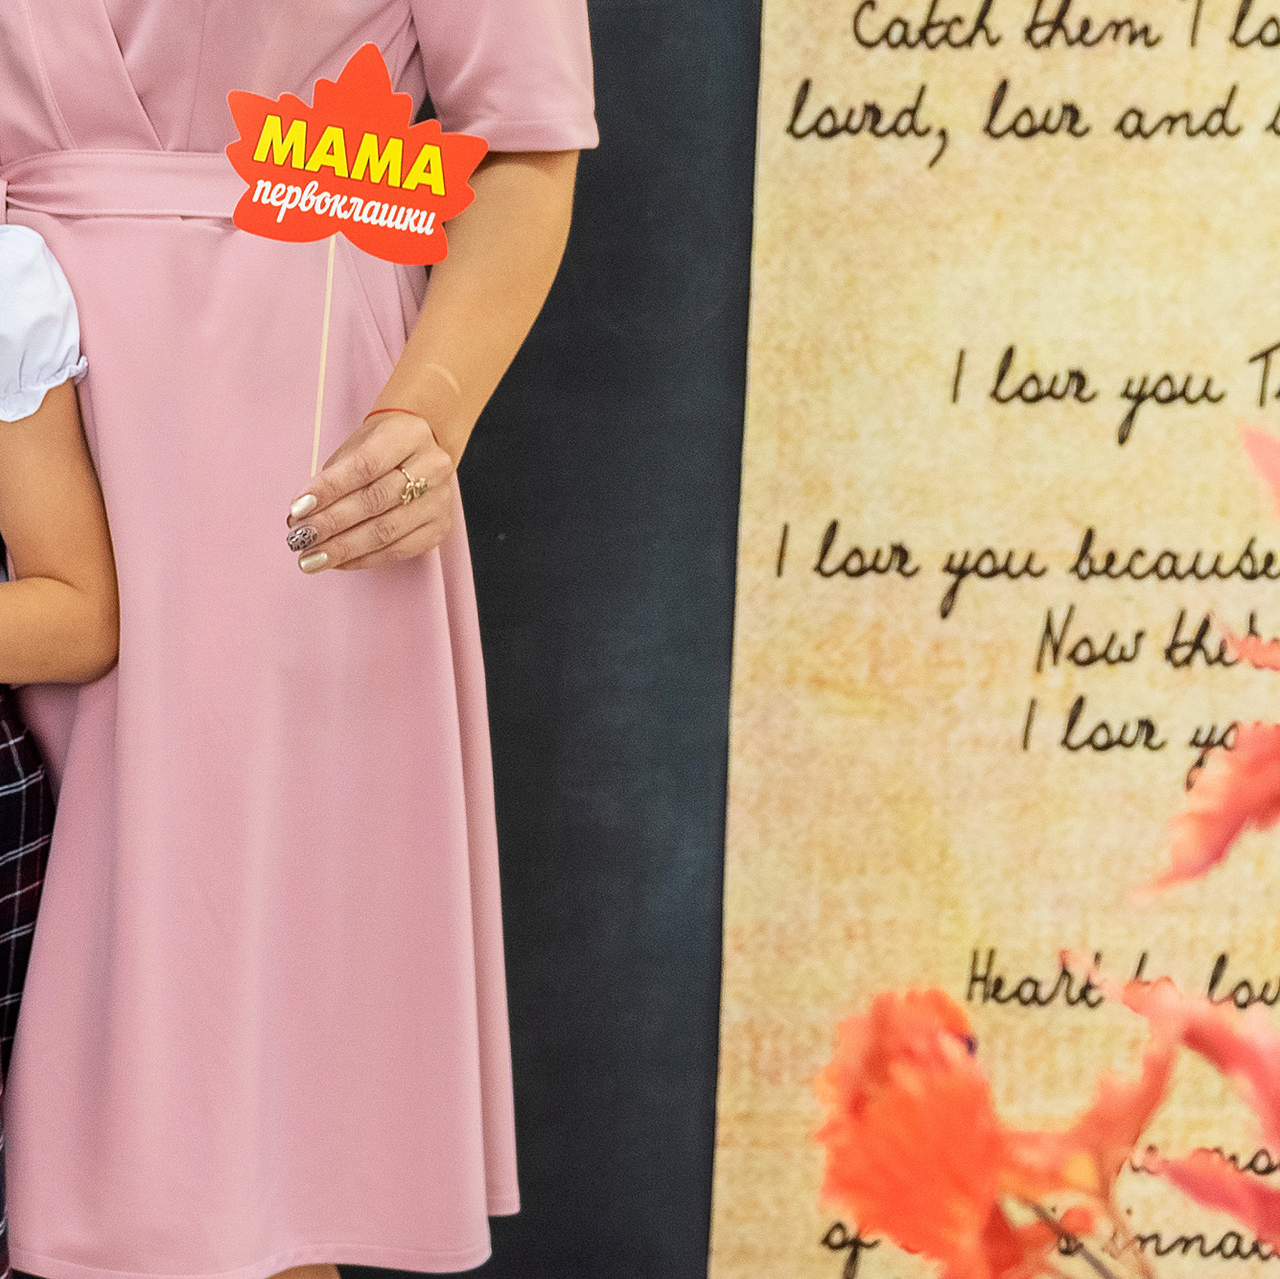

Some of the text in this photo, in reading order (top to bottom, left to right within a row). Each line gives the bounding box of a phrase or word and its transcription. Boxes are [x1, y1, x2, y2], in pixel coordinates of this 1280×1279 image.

[983, 78, 1093, 140] love
[1114, 84, 1244, 140] and
[253, 114, 446, 196] МАМА
[251, 179, 436, 236] первоклашки
[951, 347, 966, 405] I
[989, 344, 1099, 405] love
[1117, 371, 1227, 447] you
[775, 518, 1280, 621] I love you because
[1036, 604, 1148, 674] Now
[1022, 697, 1038, 751] I
[1060, 694, 1166, 751] love
[965, 947, 1104, 1009] Heart
